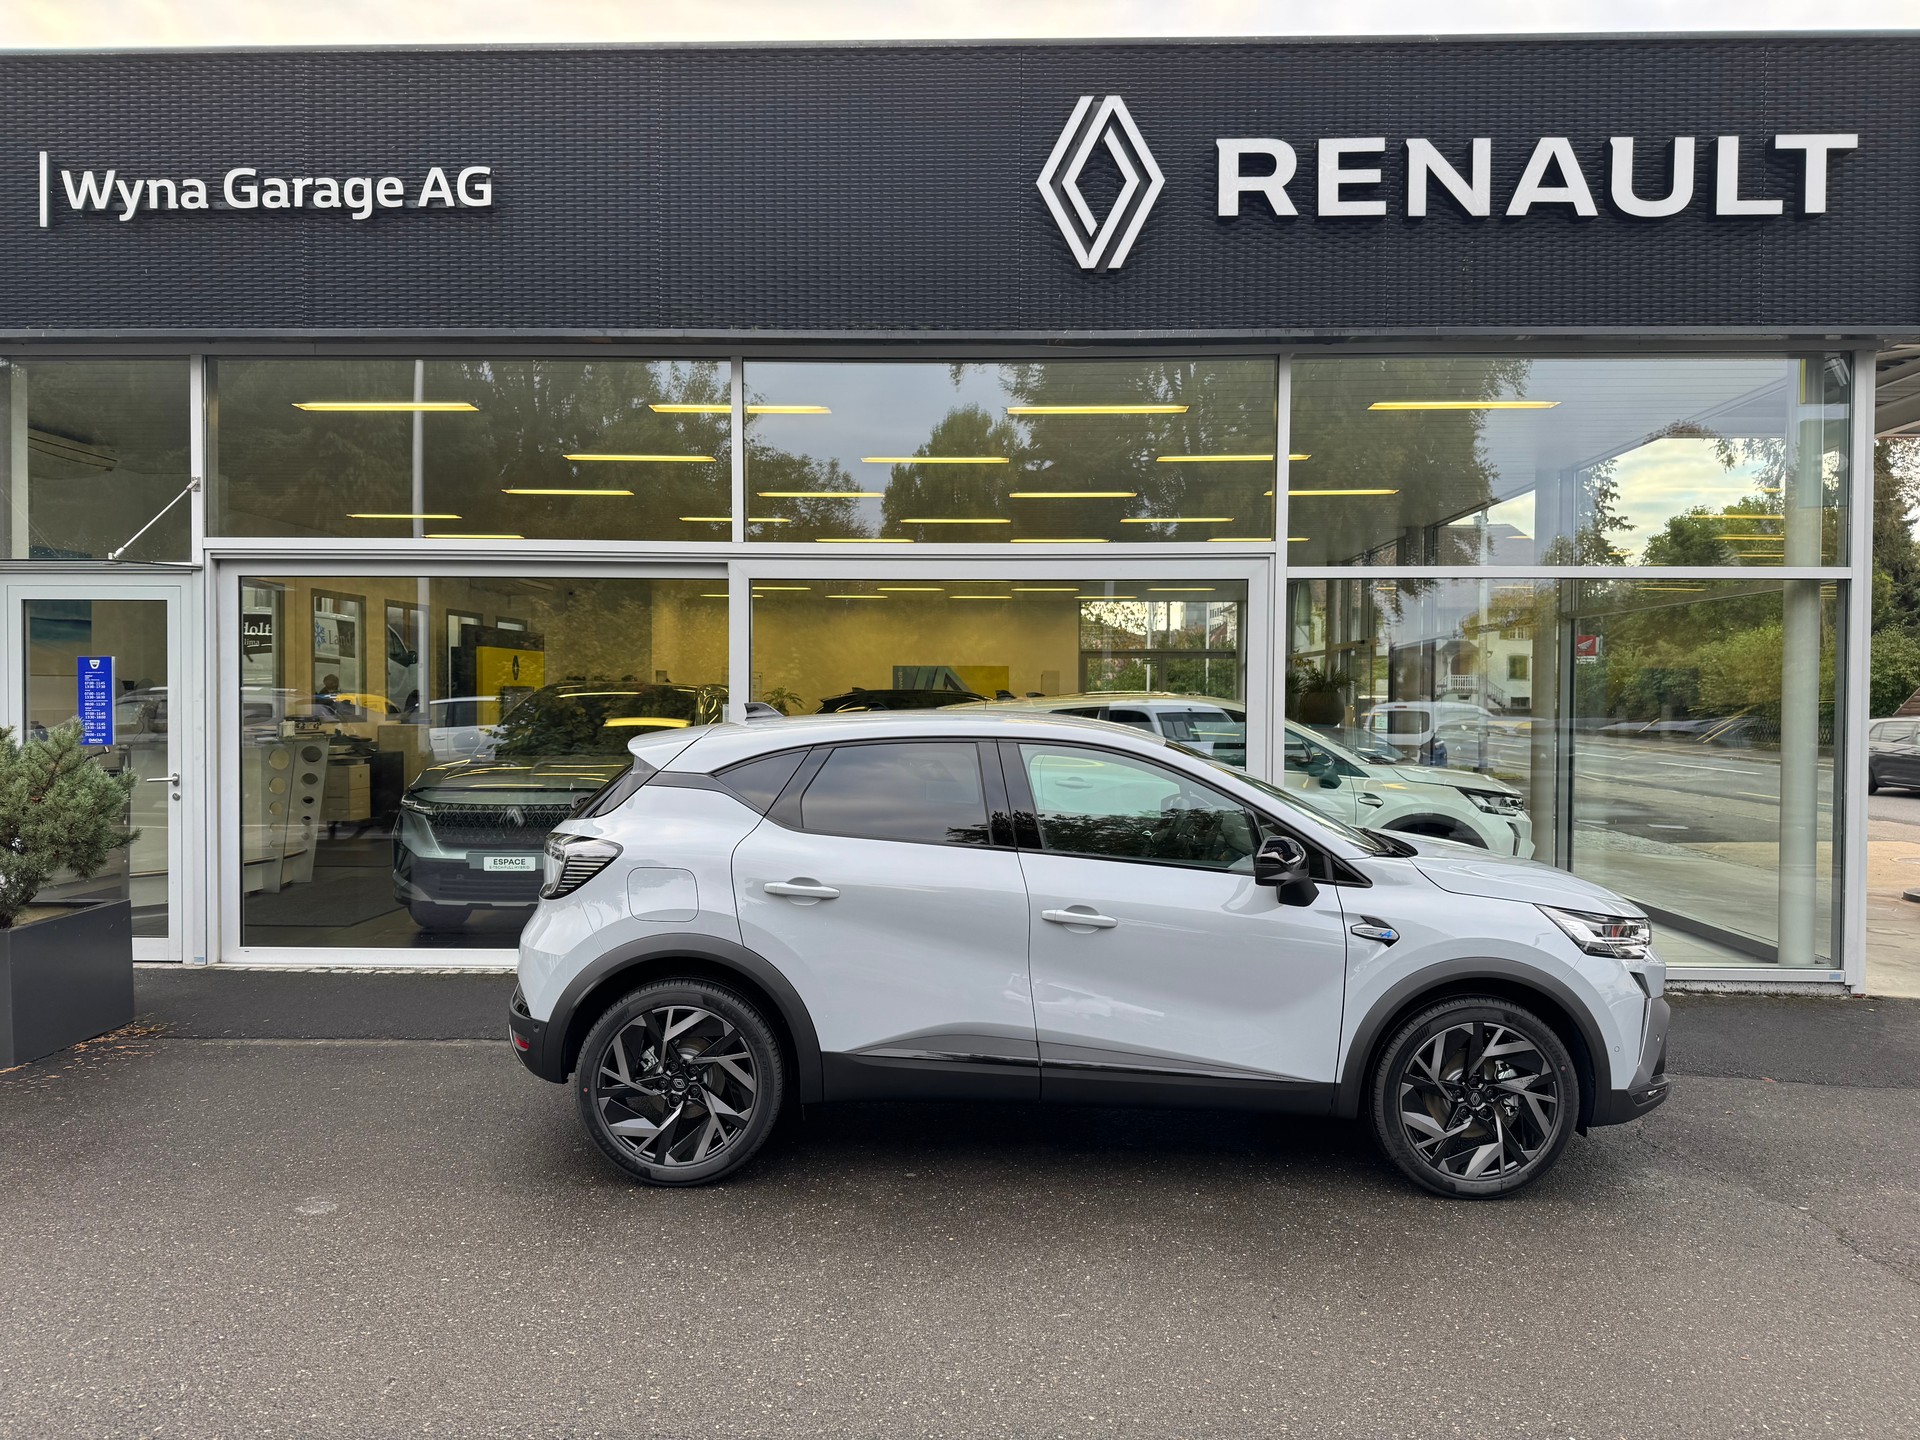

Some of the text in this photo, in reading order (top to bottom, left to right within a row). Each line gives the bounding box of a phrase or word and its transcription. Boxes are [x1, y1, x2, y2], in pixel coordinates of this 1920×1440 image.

[61, 166, 493, 221] Wyna Garage AG
[1216, 133, 1859, 217] RENAULT
[328, 629, 354, 647] Land
